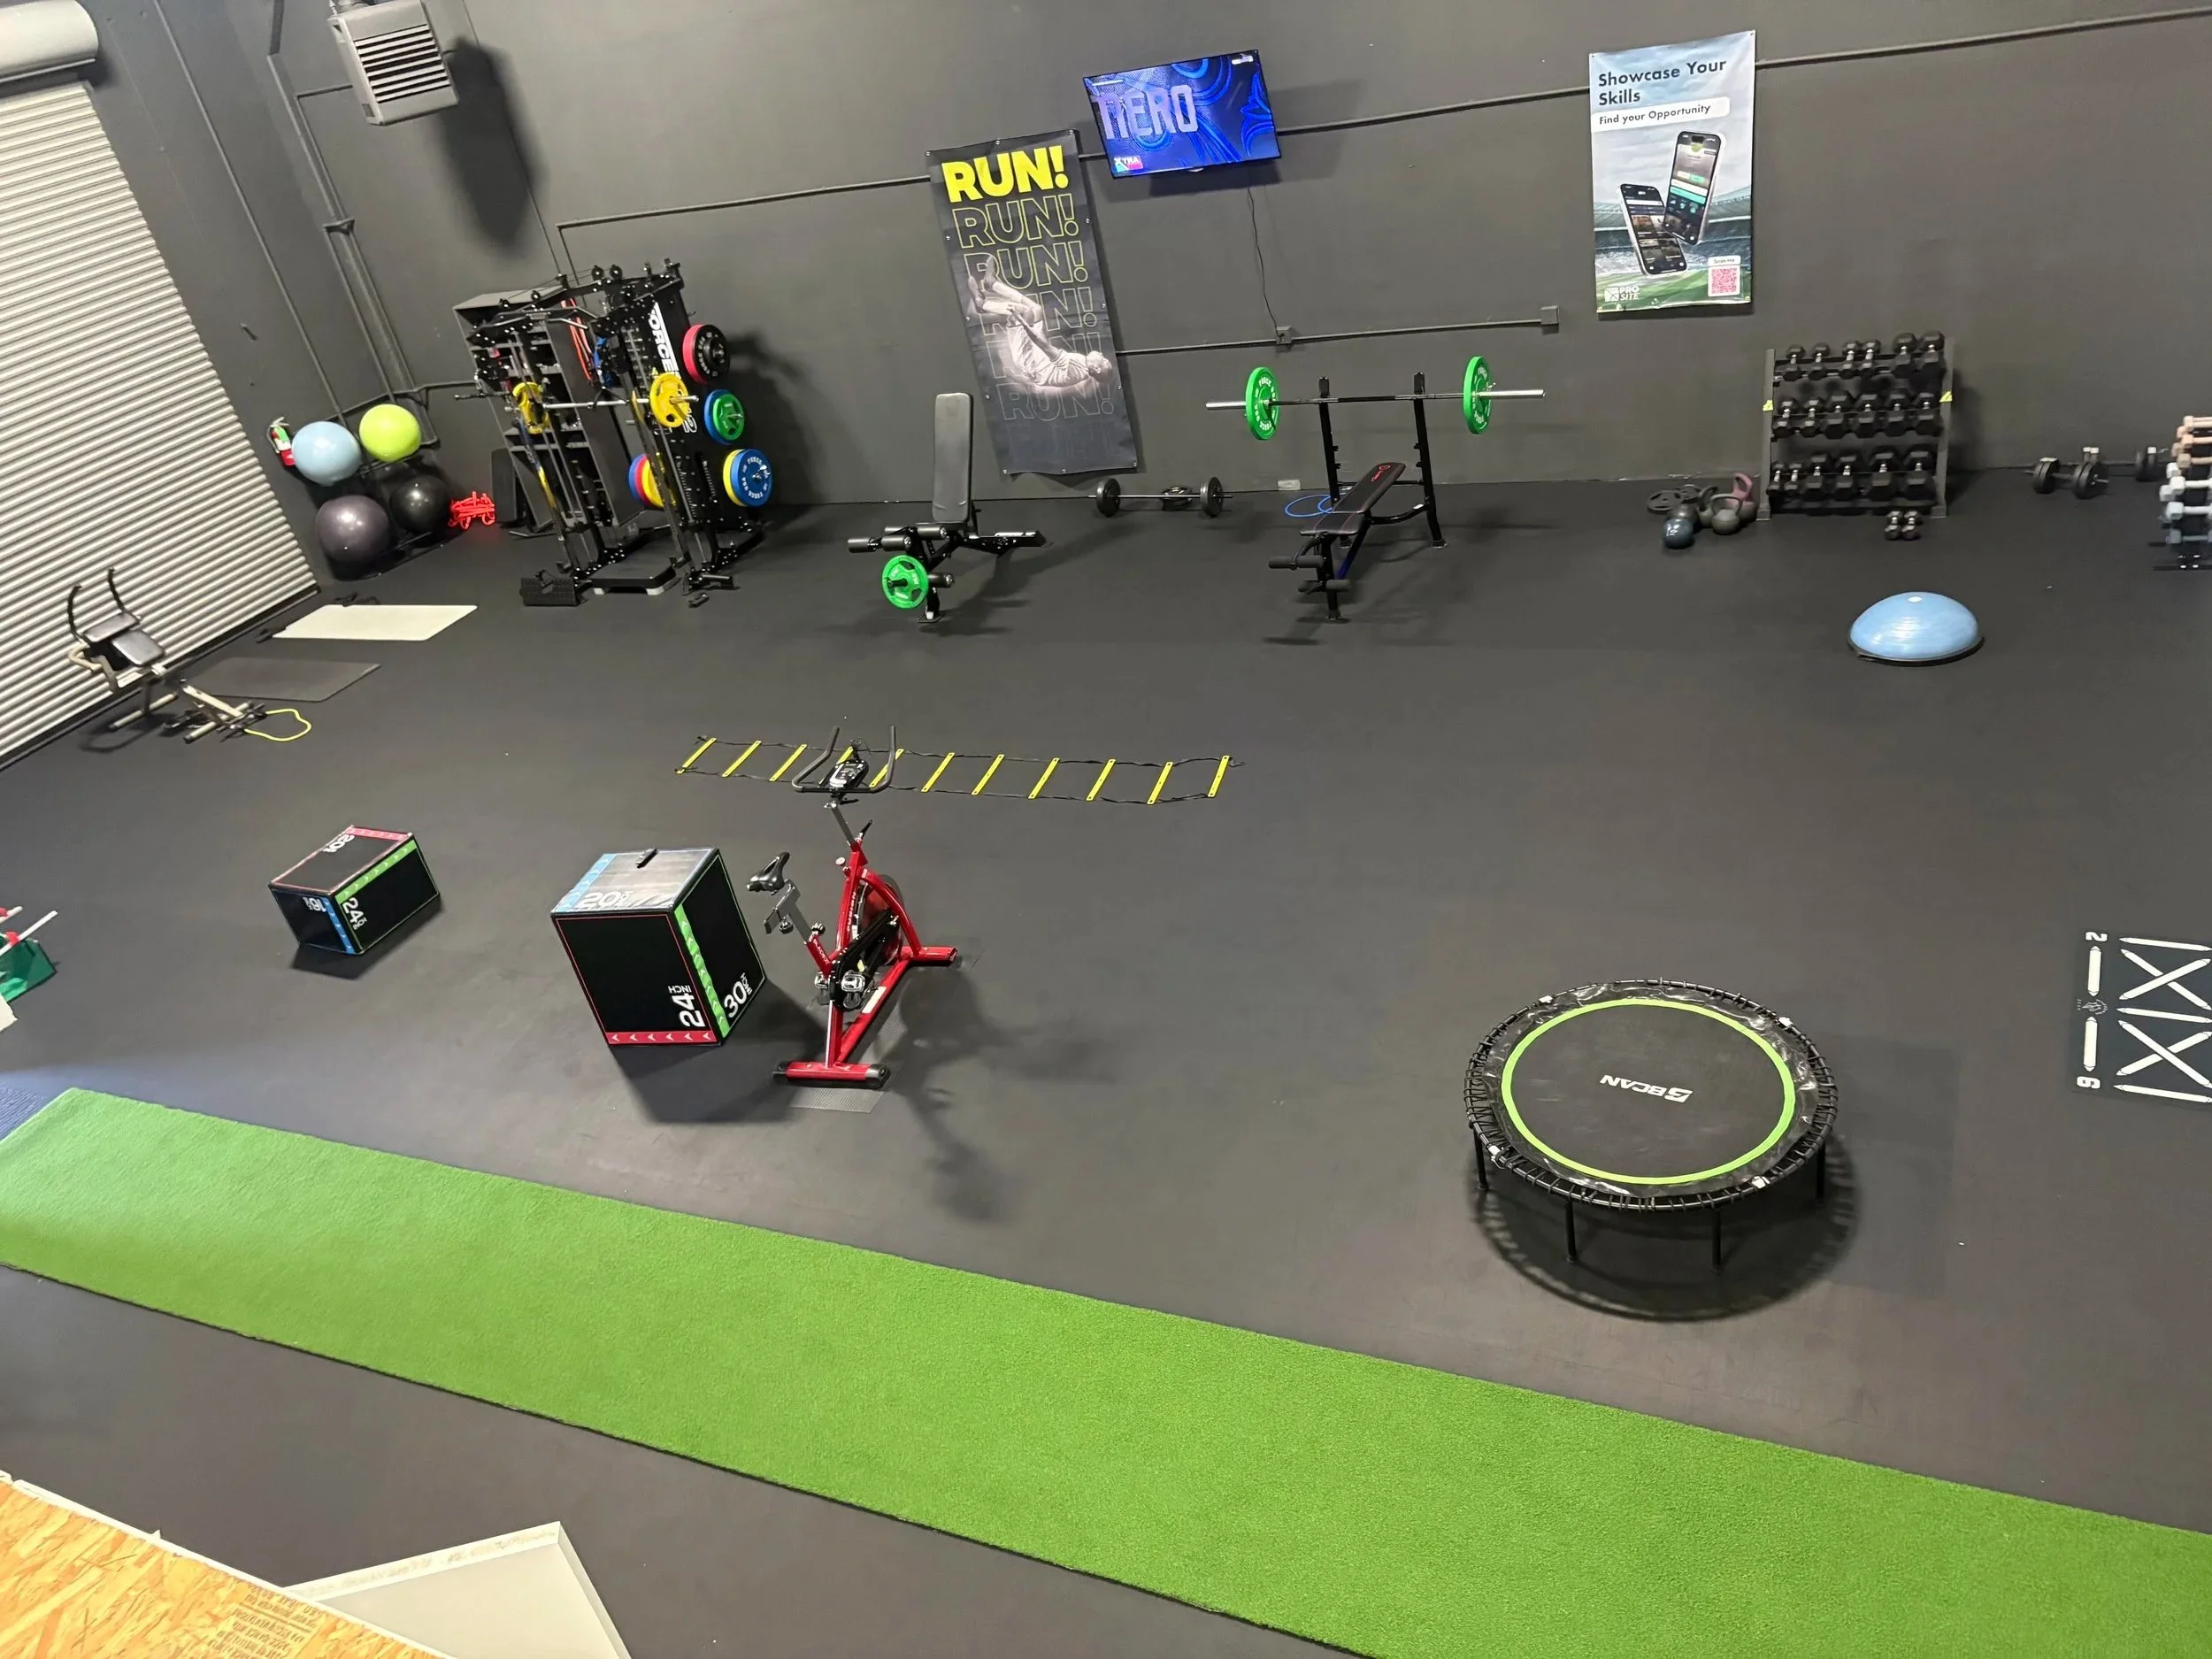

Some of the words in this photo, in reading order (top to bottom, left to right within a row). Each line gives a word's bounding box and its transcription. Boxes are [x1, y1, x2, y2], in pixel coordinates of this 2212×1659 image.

[1598, 67, 1680, 87] Showcase
[1686, 59, 1727, 76] Your
[1598, 89, 1640, 106] Skills
[1599, 114, 1619, 126] Find
[1622, 111, 1646, 125] your
[1648, 104, 1711, 120] Opportunity
[941, 145, 1069, 204] RUN!
[951, 193, 1079, 250] RUN!
[1619, 285, 1640, 294] PRO
[342, 897, 365, 924] 24
[573, 891, 622, 910] 20
[2085, 931, 2108, 942] 2
[667, 984, 692, 995] INCH
[724, 980, 748, 1019] 30
[673, 993, 706, 1028] 24
[1599, 1074, 1668, 1098] BCAN
